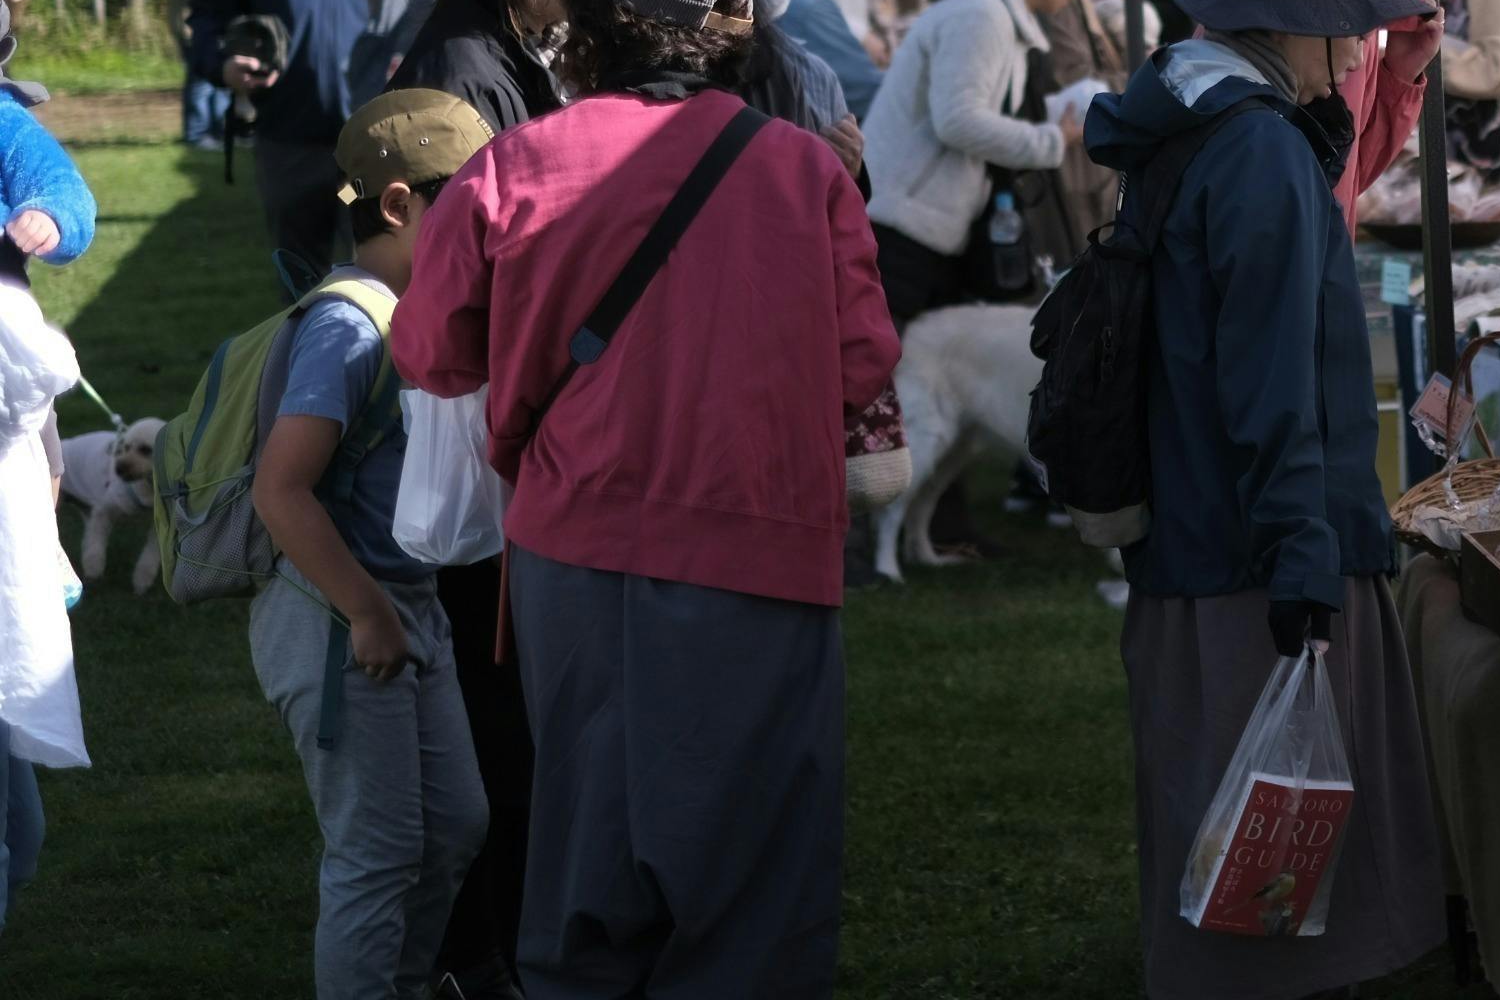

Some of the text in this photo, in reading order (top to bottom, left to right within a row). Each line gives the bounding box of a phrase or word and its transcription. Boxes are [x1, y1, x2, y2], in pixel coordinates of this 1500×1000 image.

[1255, 791, 1343, 813] SAORO
[1244, 812, 1333, 847] BIRD
[1234, 846, 1323, 871] GUDE
